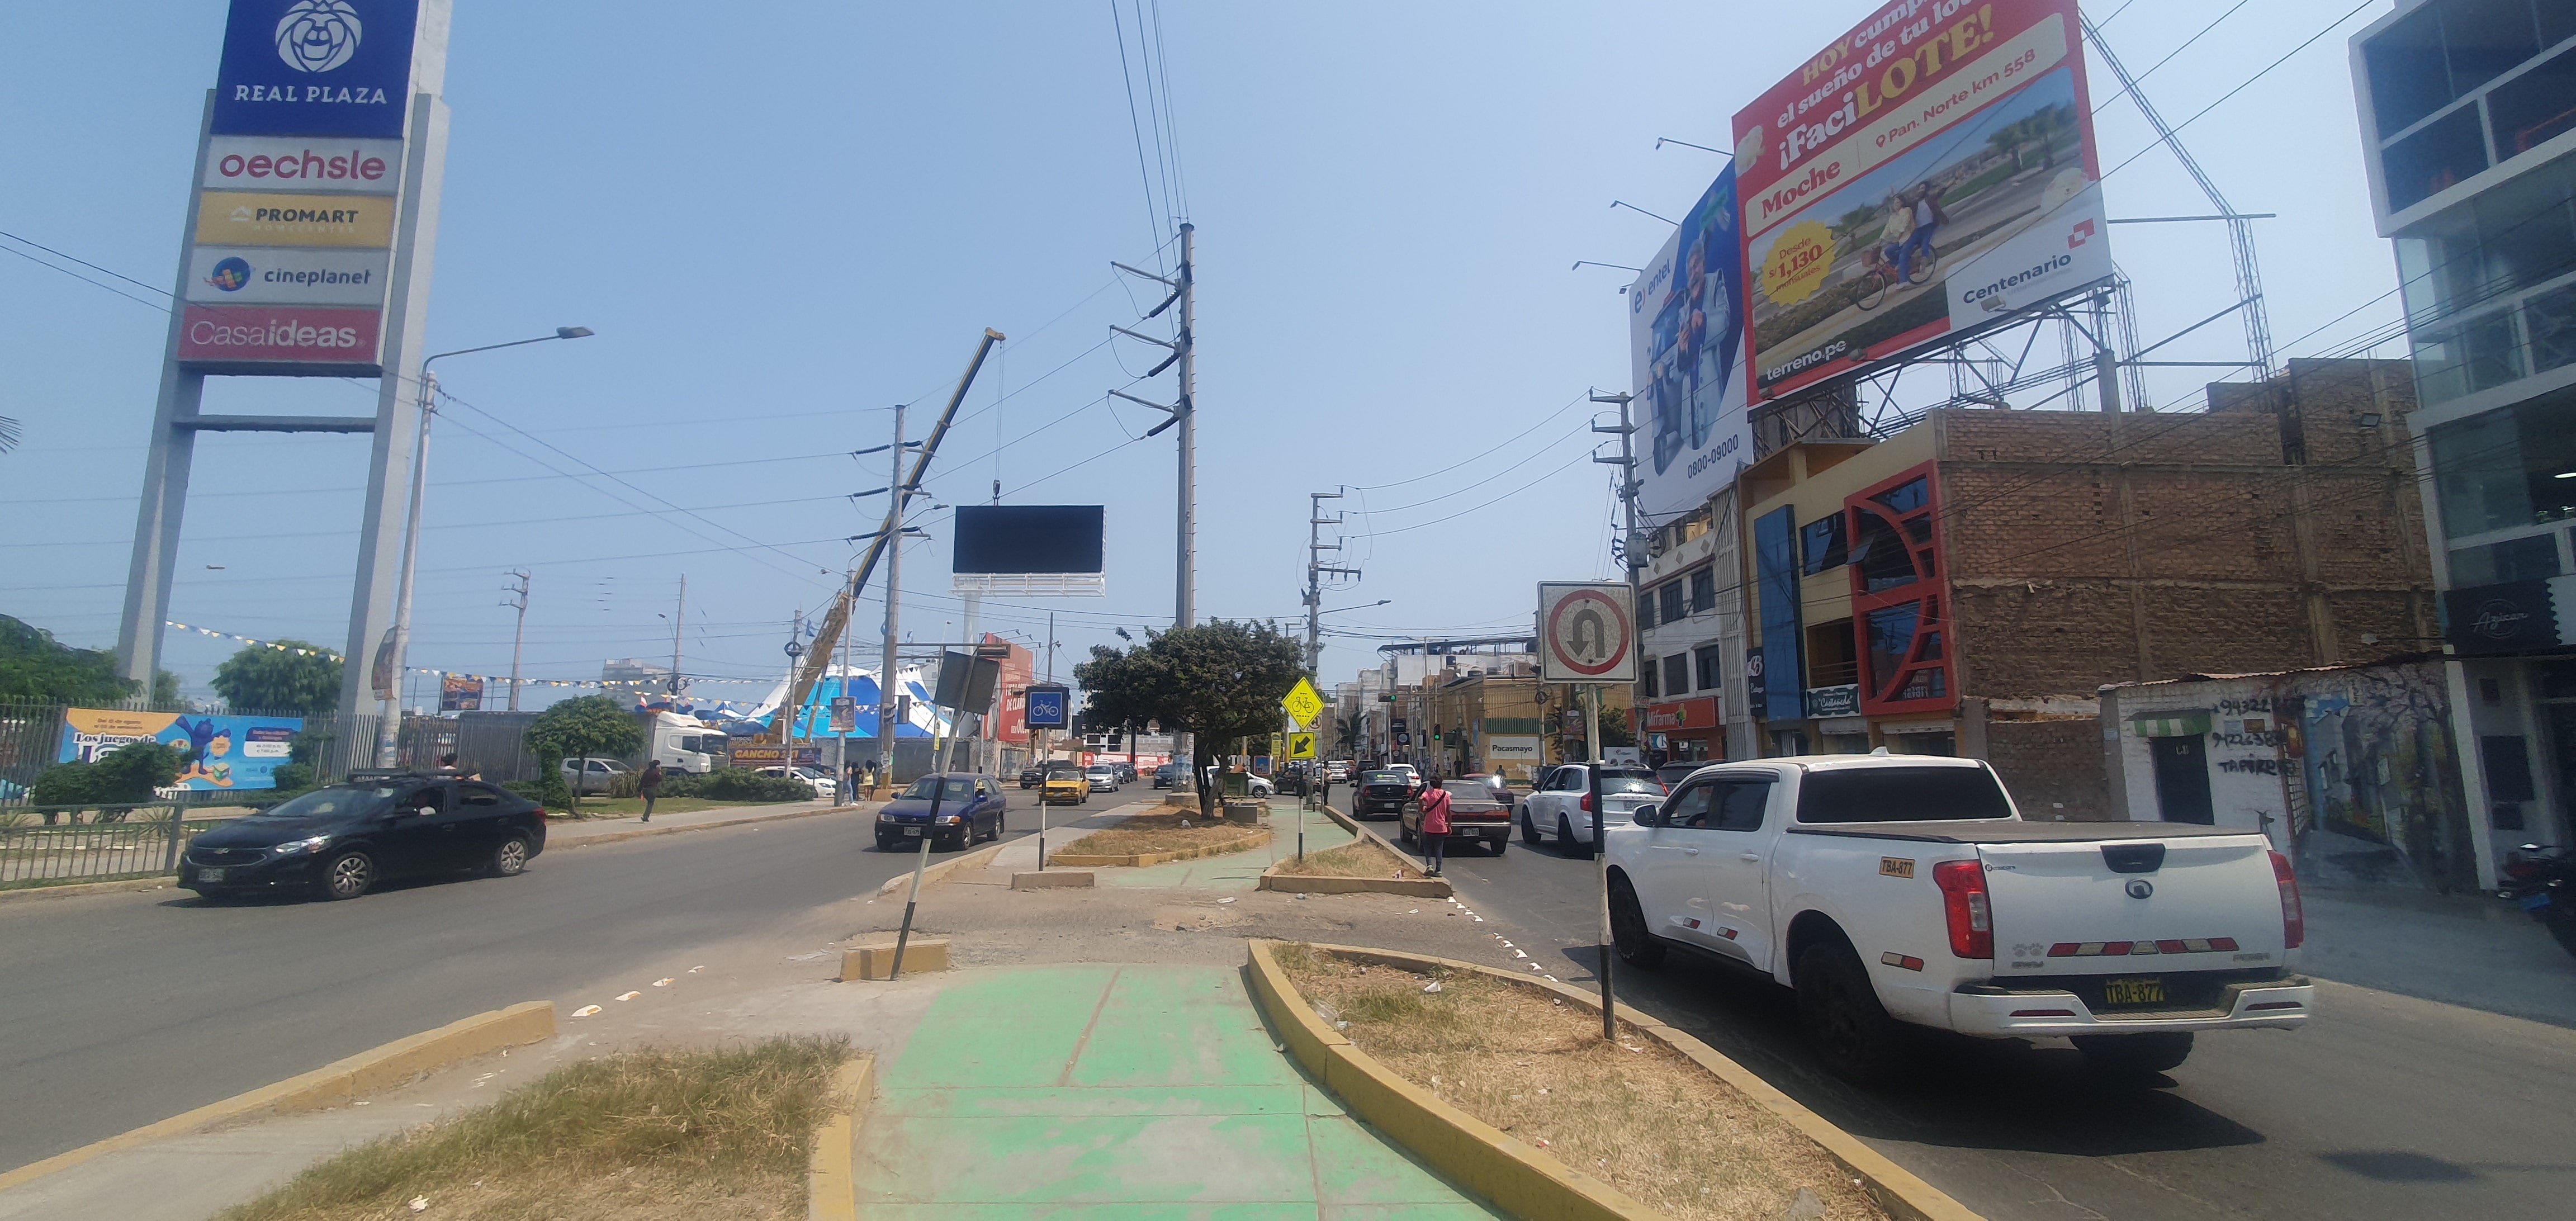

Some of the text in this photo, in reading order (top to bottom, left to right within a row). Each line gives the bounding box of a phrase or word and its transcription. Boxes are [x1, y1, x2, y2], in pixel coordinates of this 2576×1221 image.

[1777, 102, 1794, 128] el
[1798, 63, 1863, 114] sueño
[1866, 40, 1896, 68] de
[1900, 17, 1931, 45] tu
[1803, 36, 1852, 86] HOY
[235, 85, 387, 105] REAL PLAZA
[1889, 49, 2035, 142] Pan. Norte km 558
[219, 149, 386, 180] oechsle
[1761, 159, 1841, 219] Moche
[255, 208, 359, 224] PROMART
[1779, 237, 1811, 259] Desde
[264, 268, 371, 287] cineplanet
[1647, 258, 1671, 296] entel
[1775, 265, 1821, 292] mensuales
[1963, 253, 2072, 305] Centenario
[191, 319, 357, 349] Casaideas
[1766, 339, 1846, 381] terreno.pe
[1687, 433, 1739, 479] 0800-09000
[1646, 709, 1675, 727] Mifarma
[76, 733, 98, 743] Los
[1492, 745, 1533, 754] Pacasmayo
[735, 750, 779, 760] GANCHO
[1882, 859, 1913, 875] TBA-877
[2106, 983, 2165, 1004] TBA-877
